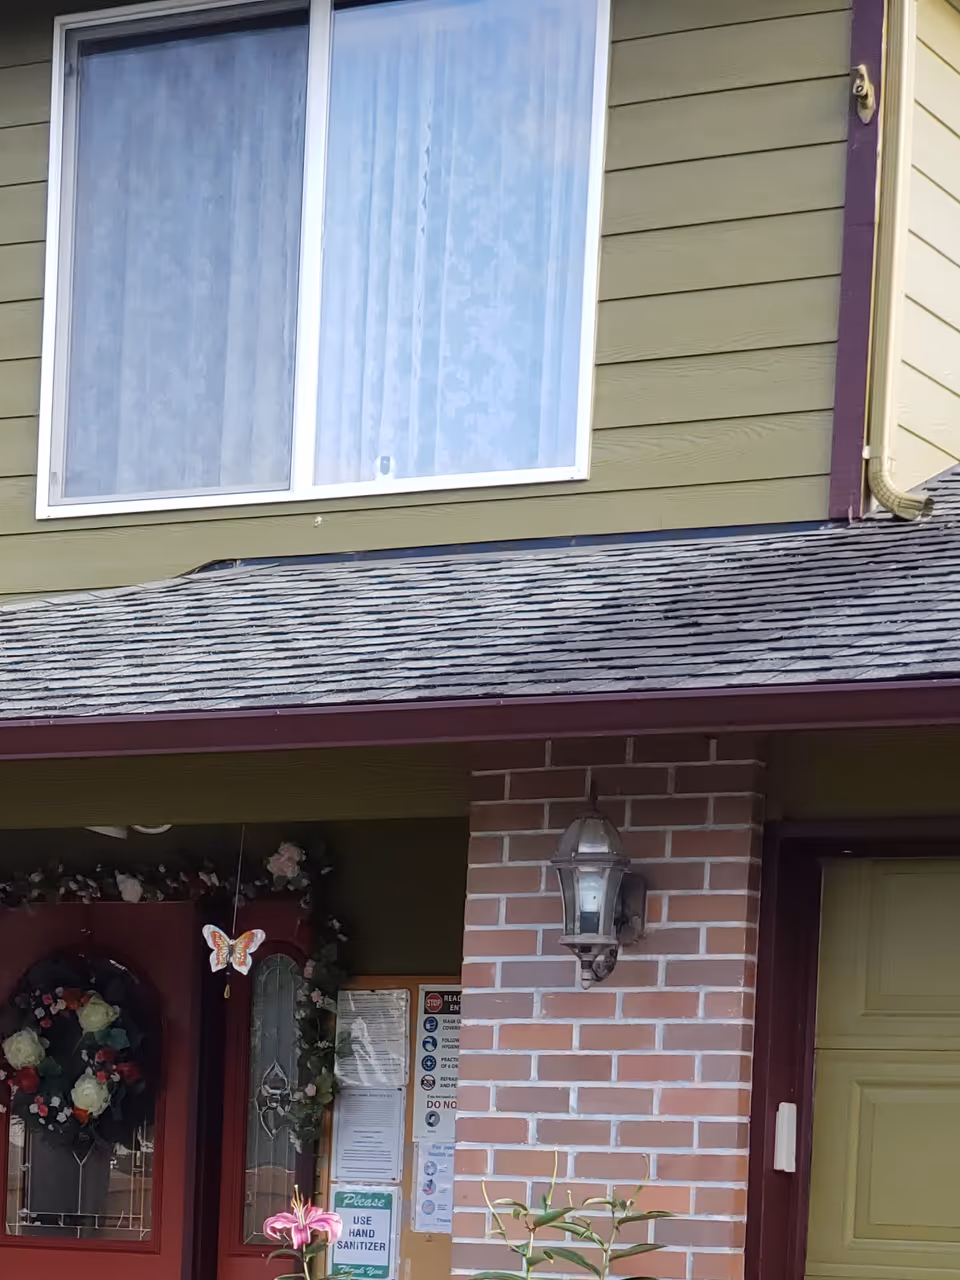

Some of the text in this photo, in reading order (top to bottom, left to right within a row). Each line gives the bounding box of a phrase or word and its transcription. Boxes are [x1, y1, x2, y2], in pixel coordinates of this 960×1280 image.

[427, 998, 441, 1007] STOP
[427, 1100, 441, 1109] DO
[342, 1193, 385, 1207] Please
[353, 1216, 372, 1225] USE
[348, 1229, 375, 1238] HAND
[337, 1240, 386, 1251] SANITIZER
[366, 1266, 384, 1276] You
